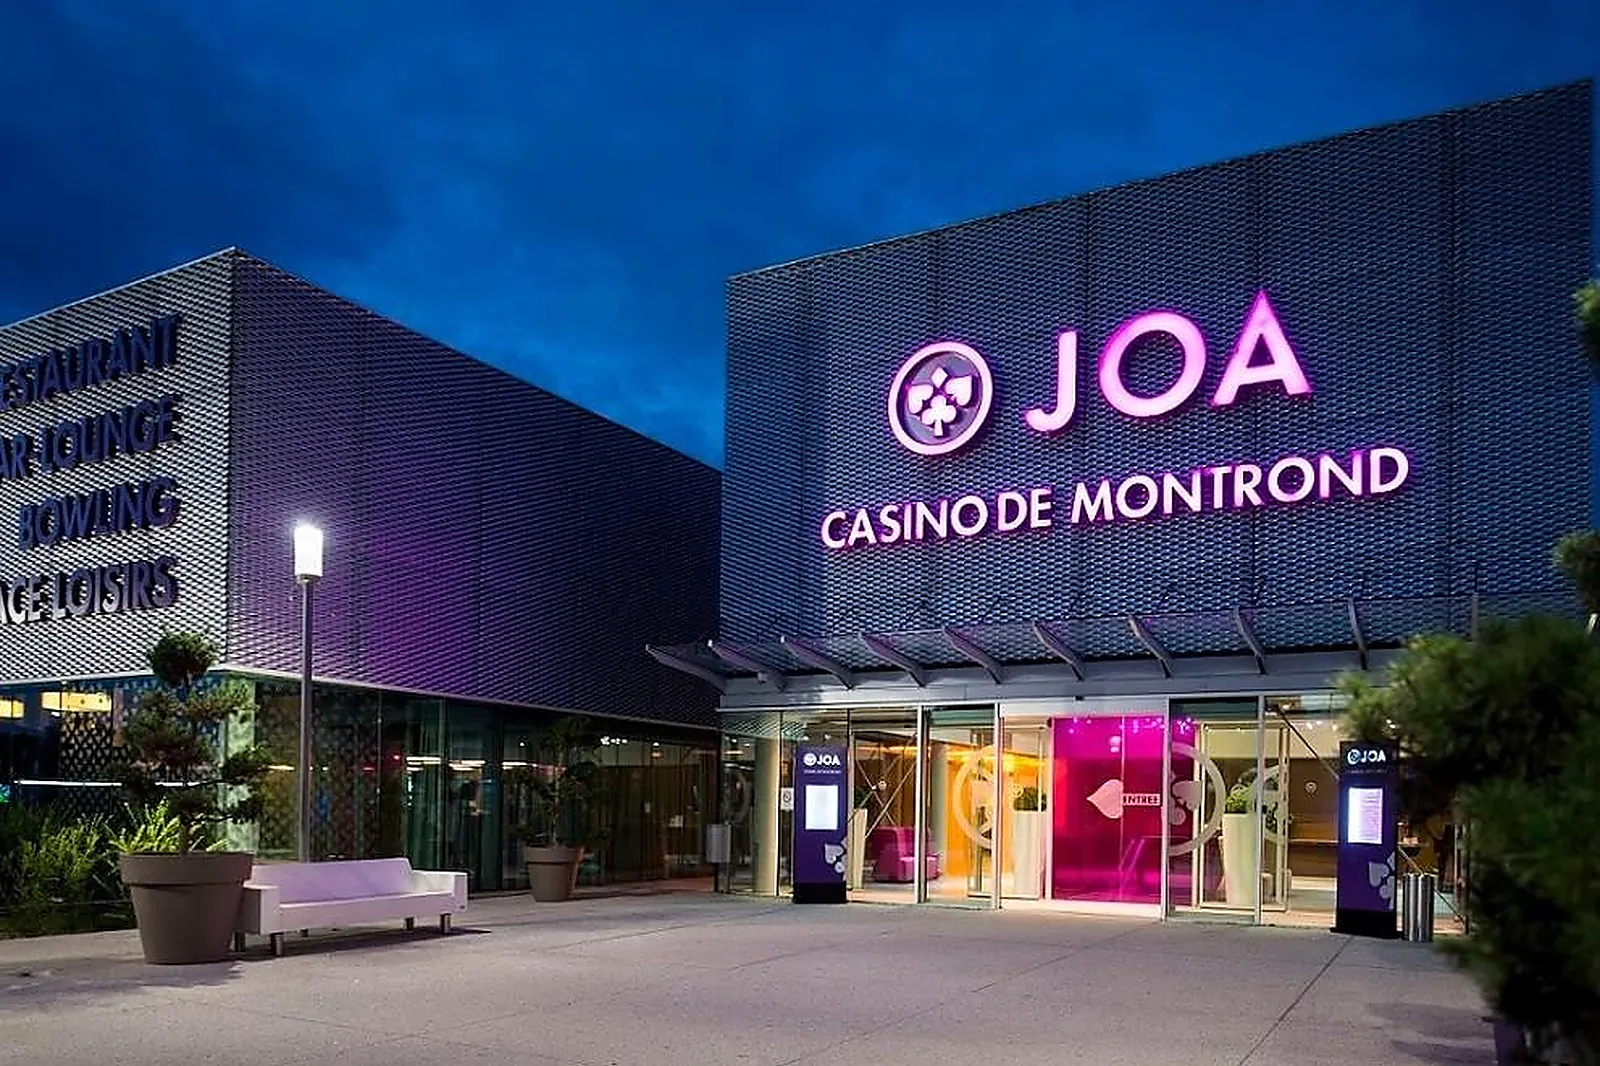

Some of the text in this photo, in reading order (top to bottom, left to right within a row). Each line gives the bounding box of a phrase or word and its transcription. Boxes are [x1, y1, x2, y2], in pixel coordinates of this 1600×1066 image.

[1025, 289, 1313, 434] JOA
[39, 394, 180, 473] LOUNGE
[19, 476, 179, 551] BOWLING
[820, 447, 1410, 549] CASINO DE MONTROND
[52, 555, 177, 620] LOISIRS
[816, 753, 841, 766] JOA
[1360, 749, 1387, 763] JOA
